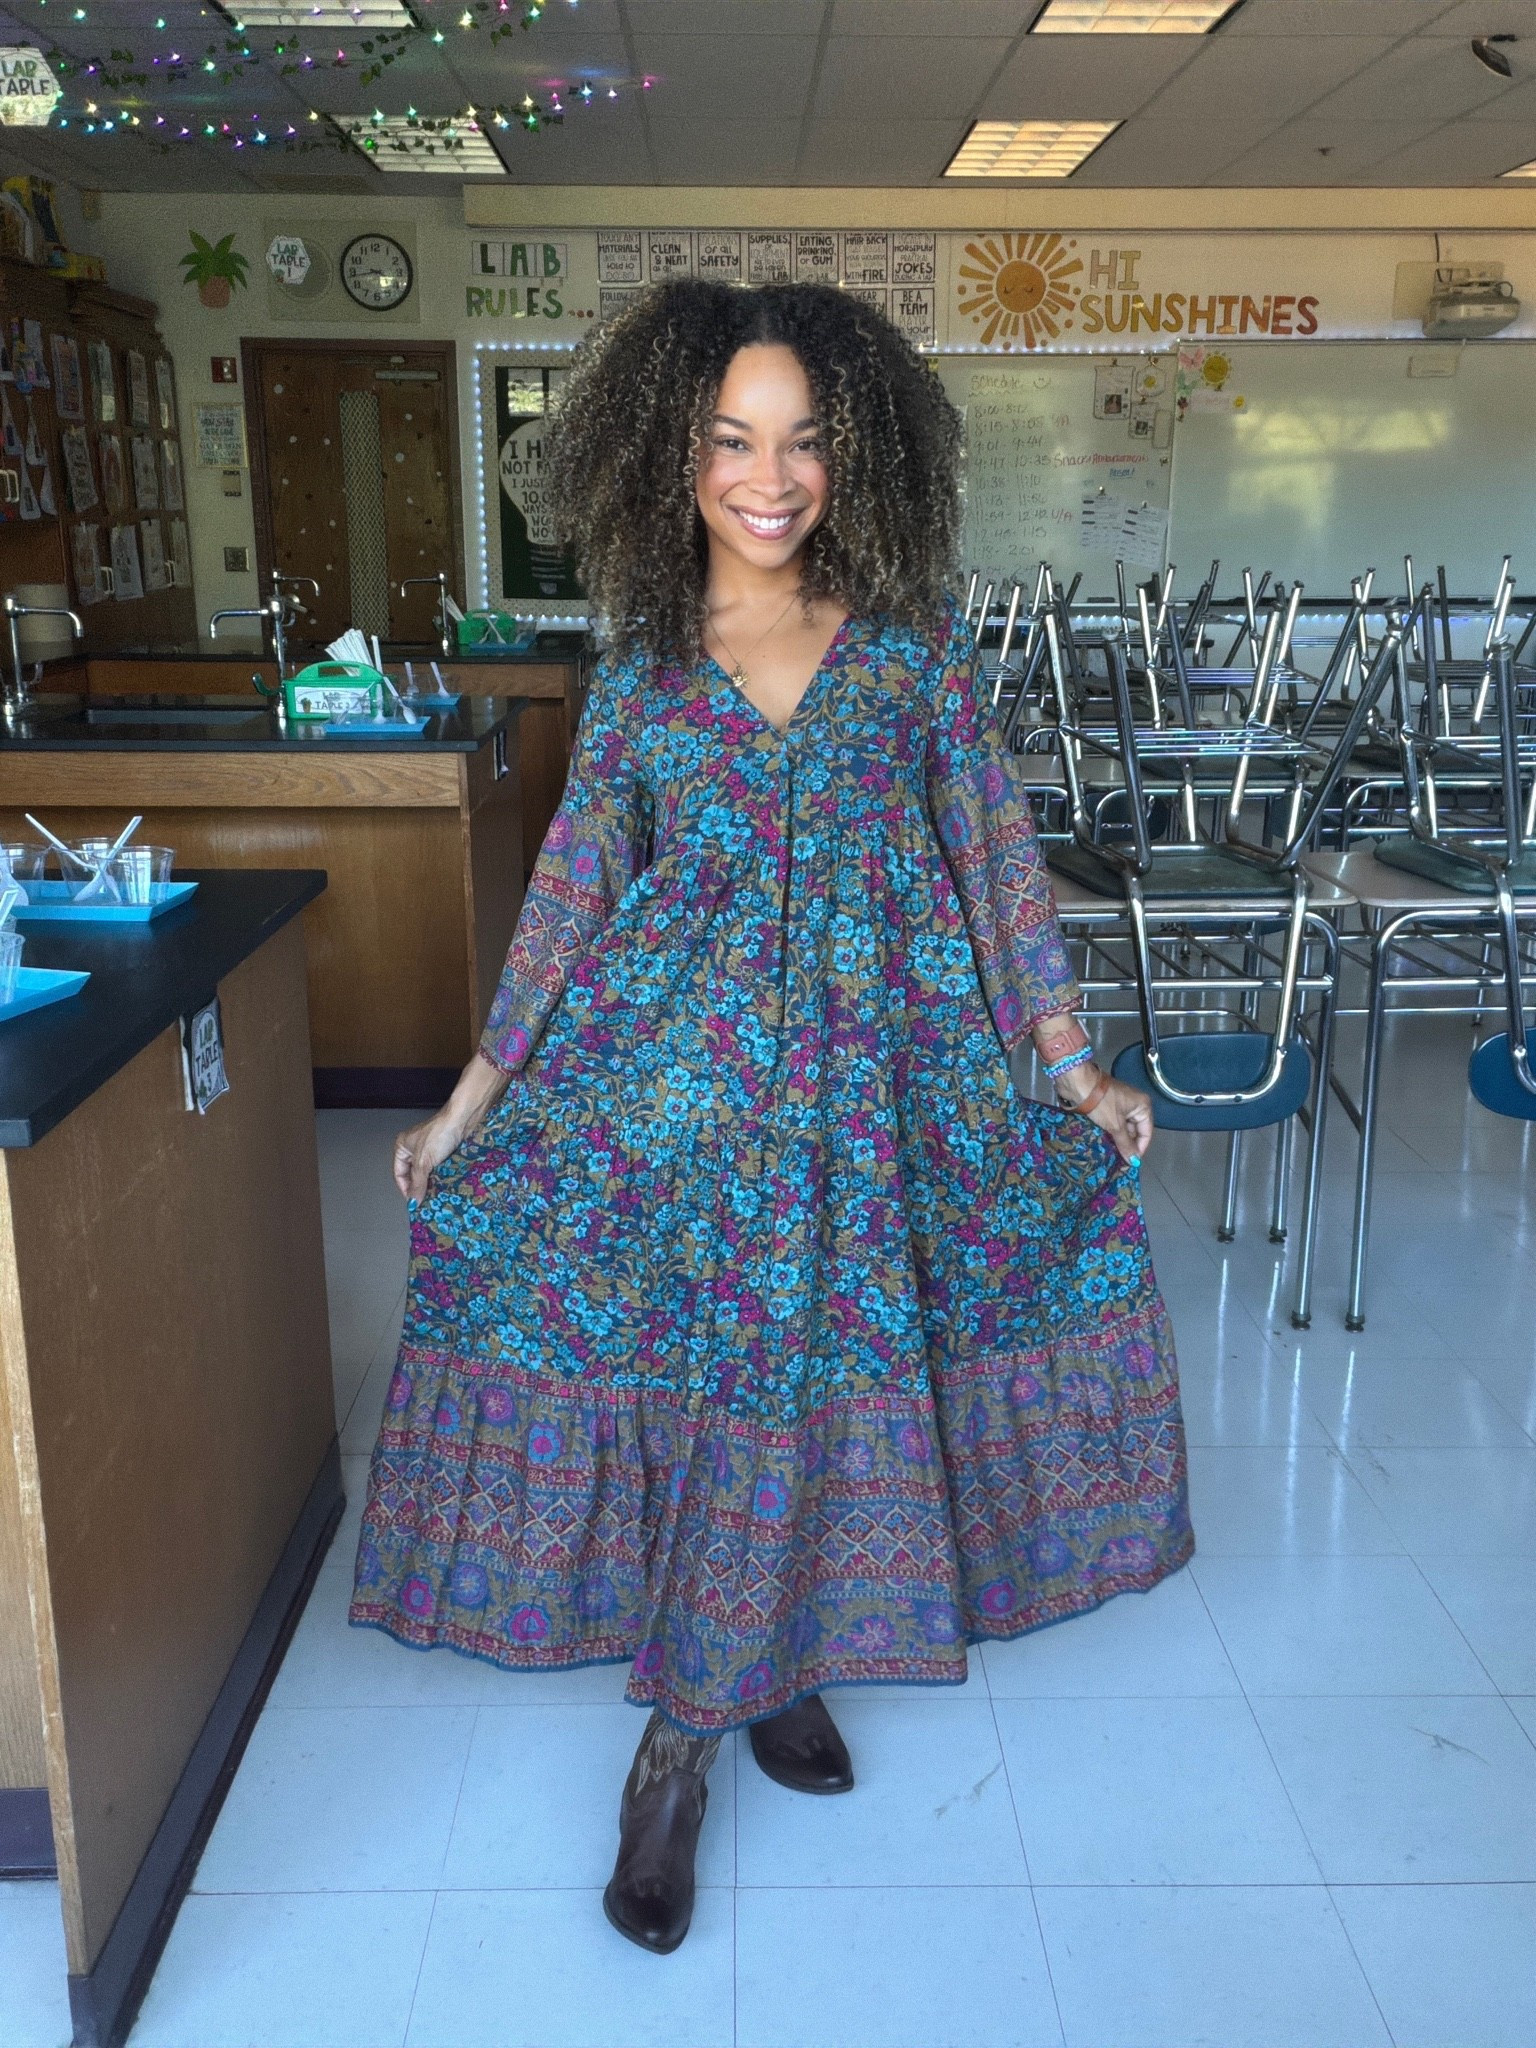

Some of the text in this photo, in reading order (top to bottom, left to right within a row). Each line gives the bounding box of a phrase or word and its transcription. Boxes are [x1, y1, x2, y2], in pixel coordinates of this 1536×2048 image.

[800, 236, 835, 247] EATING,
[847, 236, 864, 245] HAIR
[866, 236, 887, 245] BACK
[277, 244, 298, 256] LAB
[599, 244, 640, 253] MATERIALS
[651, 244, 681, 254] CLEAN
[797, 247, 836, 256] DRINKING,
[271, 254, 306, 268] TABLE
[480, 243, 560, 277] LAB
[655, 255, 688, 265] & NEAT
[700, 255, 739, 267] SAFETY
[812, 256, 833, 265] GUM
[895, 262, 933, 274] JOKES
[1089, 250, 1142, 290] HI
[772, 271, 788, 280] LAB
[862, 269, 885, 280] FIRE
[903, 290, 923, 303] BE A
[899, 303, 928, 315] TEAM
[1080, 293, 1320, 335] SUNSHINES
[907, 326, 931, 335] your
[509, 440, 518, 459] I
[502, 460, 530, 474] NOT
[512, 479, 546, 489] I JUST
[522, 505, 547, 514] WAYS
[199, 1018, 214, 1050] LAB
[195, 1040, 218, 1078] TABLE
